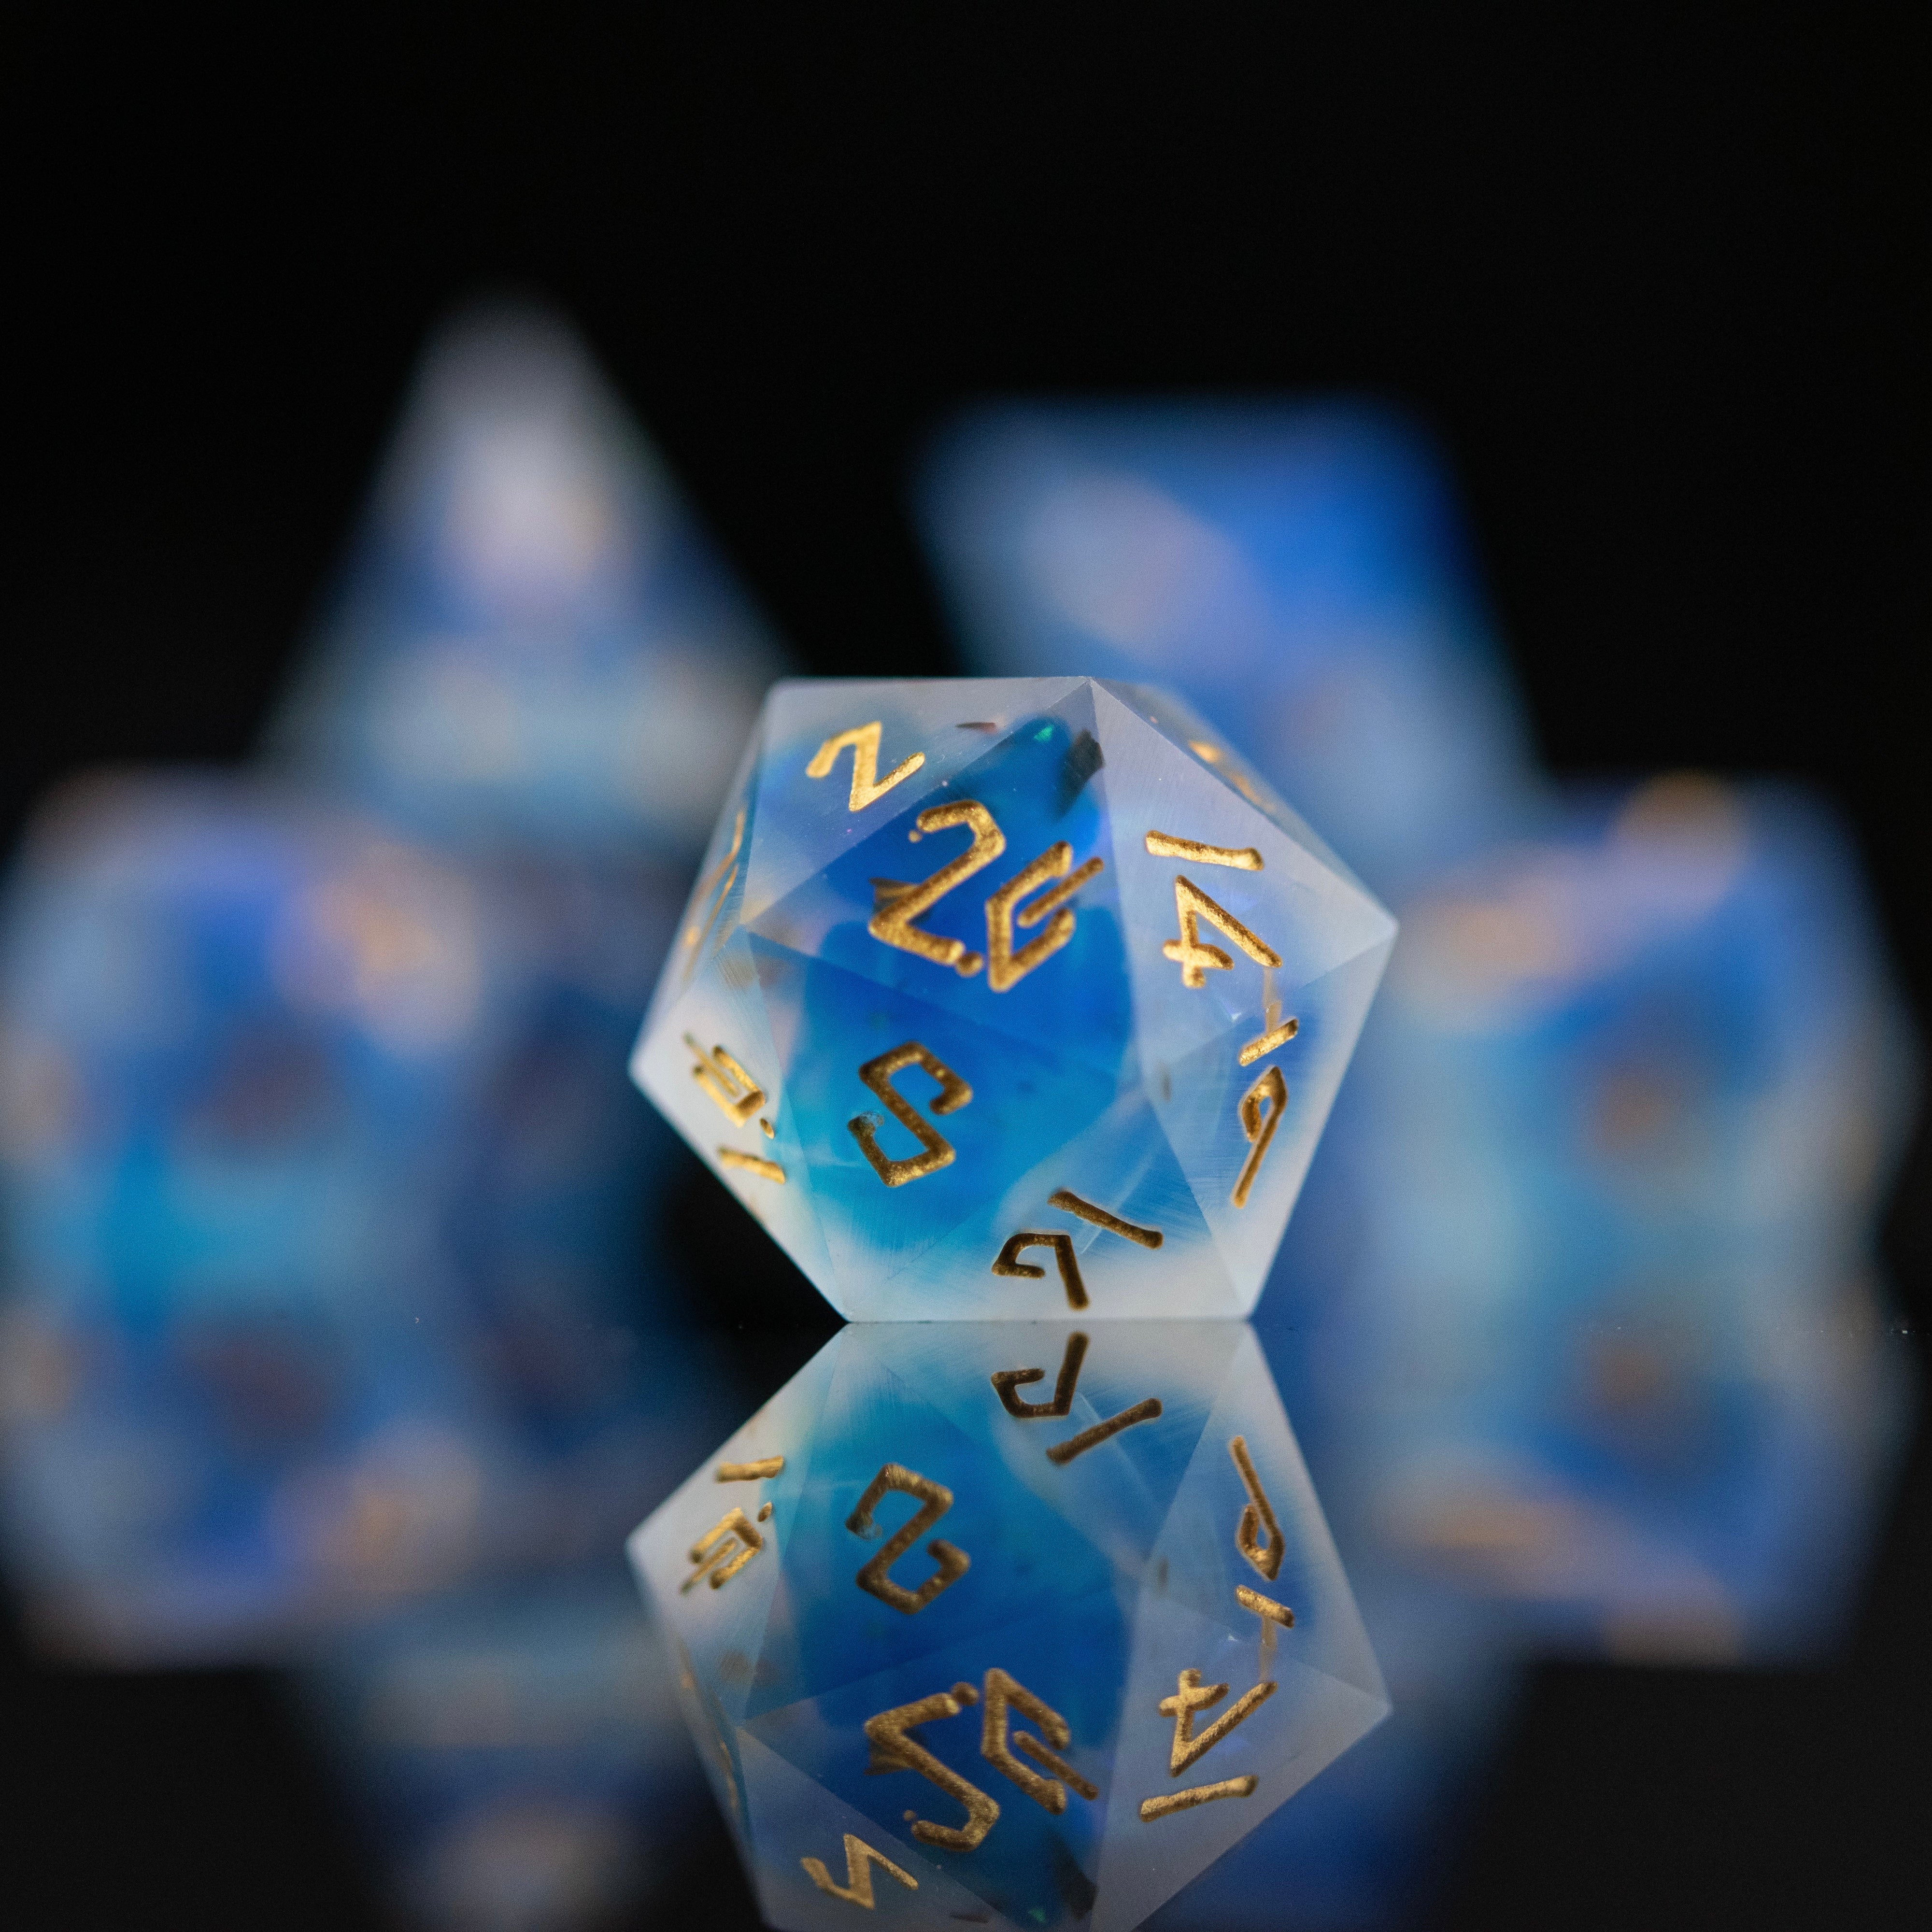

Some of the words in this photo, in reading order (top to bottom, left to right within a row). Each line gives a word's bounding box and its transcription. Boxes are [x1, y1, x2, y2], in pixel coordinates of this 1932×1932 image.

[806, 722, 925, 812] 2
[868, 799, 1104, 993] 20
[1145, 830, 1283, 989] 14
[847, 1041, 974, 1188] 8
